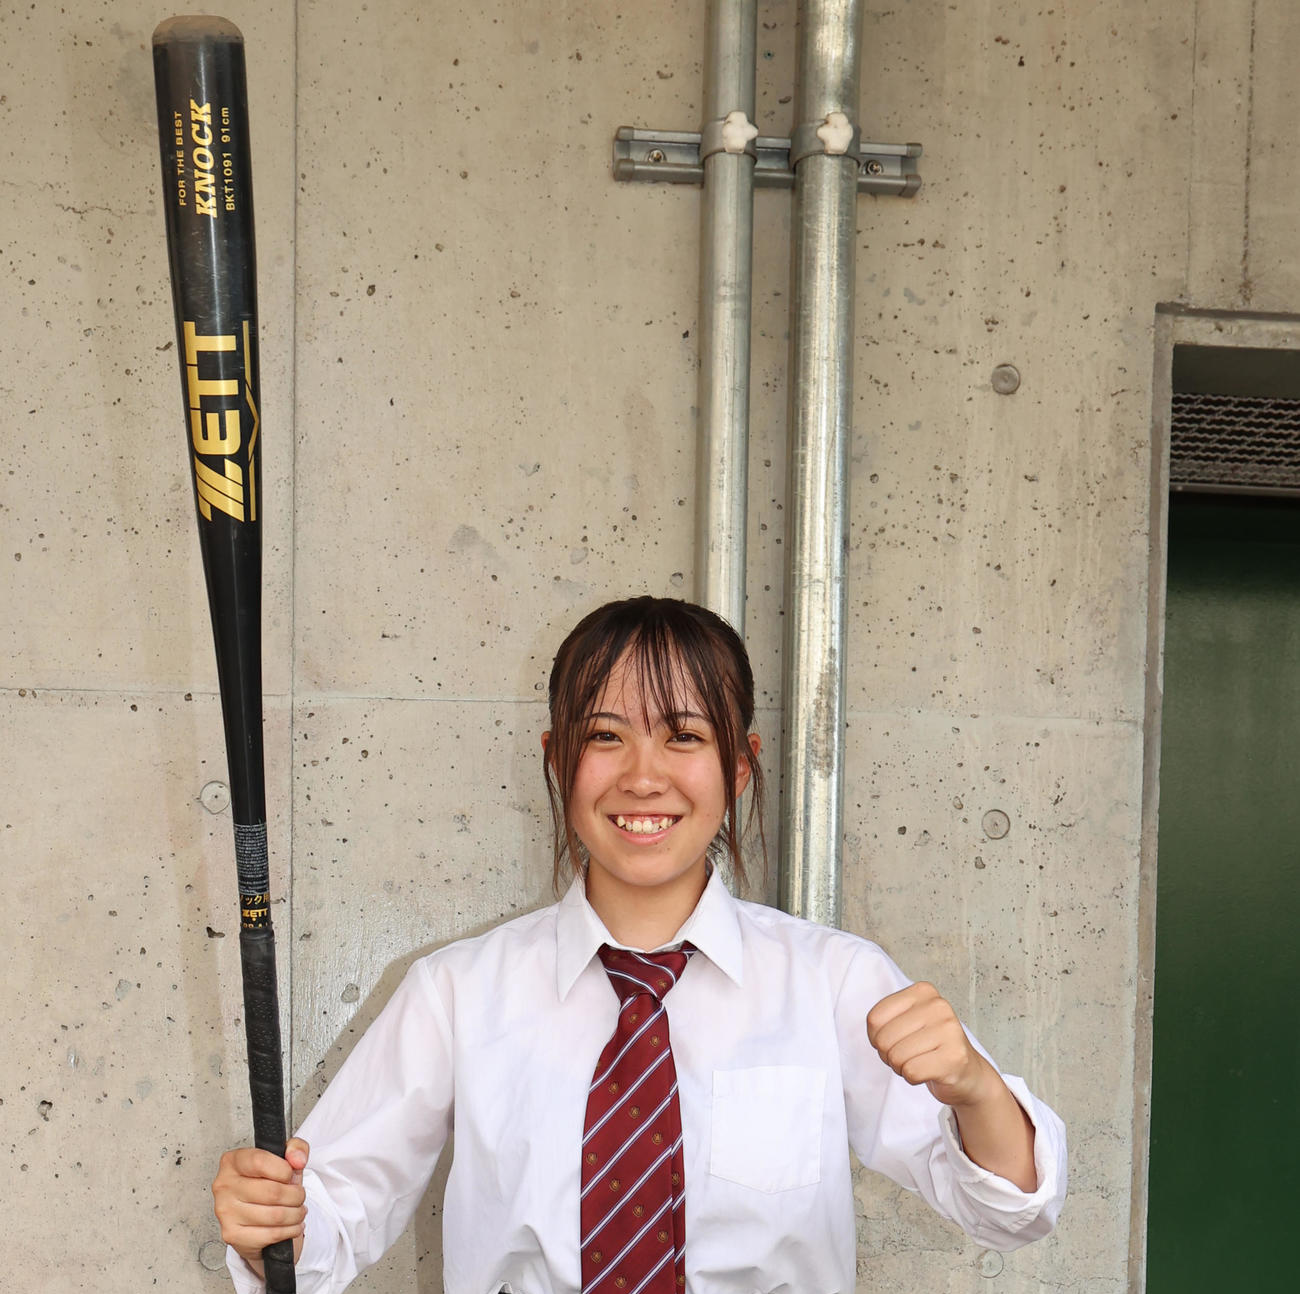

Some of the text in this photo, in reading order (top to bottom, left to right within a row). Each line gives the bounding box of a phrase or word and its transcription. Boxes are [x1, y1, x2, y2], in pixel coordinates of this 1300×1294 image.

[174, 111, 187, 206] FOR THE BEST
[190, 98, 218, 219] KNOCK
[221, 107, 236, 211] BKT1091 91cm
[183, 320, 245, 522] ZETT
[242, 908, 268, 918] ZETT
